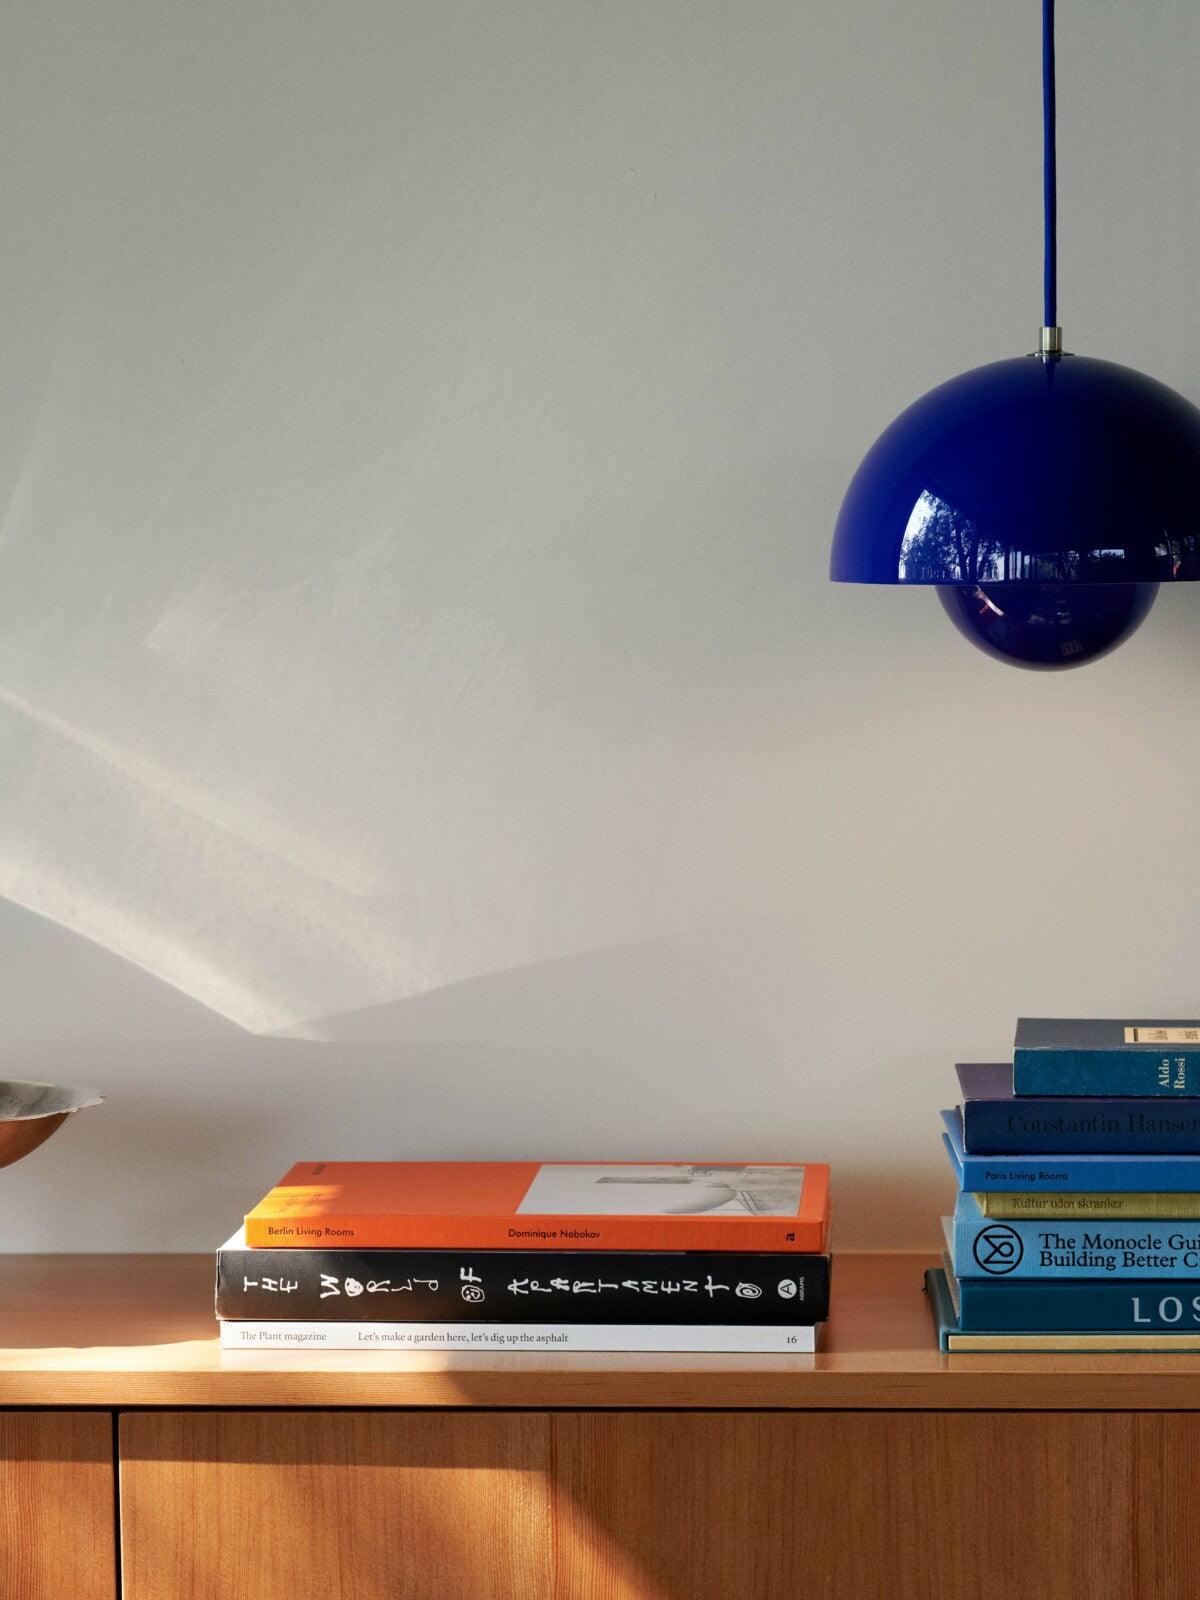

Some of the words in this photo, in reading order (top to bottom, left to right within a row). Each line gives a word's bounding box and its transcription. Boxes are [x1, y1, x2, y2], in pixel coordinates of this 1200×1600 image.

[1158, 1058, 1170, 1088] Aldo
[1173, 1057, 1186, 1090] Rossi
[1007, 1112, 1120, 1133] Constantin
[985, 1171, 1007, 1181] Paris
[1009, 1171, 1036, 1182] Living
[1038, 1171, 1069, 1181] Rooms
[1012, 1197, 1048, 1209] Kultur
[1050, 1197, 1075, 1209] uden
[1077, 1197, 1125, 1209] skranker
[268, 1226, 294, 1236] Berlin
[296, 1227, 322, 1237] Living
[325, 1227, 355, 1237] Rooms
[508, 1228, 558, 1239] Dominique
[560, 1229, 601, 1239] Nabokov
[1039, 1233, 1076, 1250] The
[1083, 1233, 1162, 1250] Monocle
[1039, 1251, 1117, 1271] Building
[1122, 1251, 1178, 1268] Better
[243, 1276, 298, 1294] THE
[240, 1331, 257, 1341] The
[259, 1331, 282, 1341] Plant
[284, 1331, 327, 1343] magazine
[381, 1332, 406, 1342] make
[414, 1332, 445, 1343] garden
[446, 1332, 470, 1343] here,
[490, 1333, 505, 1344] dig
[507, 1335, 518, 1344] up
[520, 1333, 534, 1343] the
[536, 1333, 569, 1344] asphalt
[786, 1336, 798, 1344] 16
